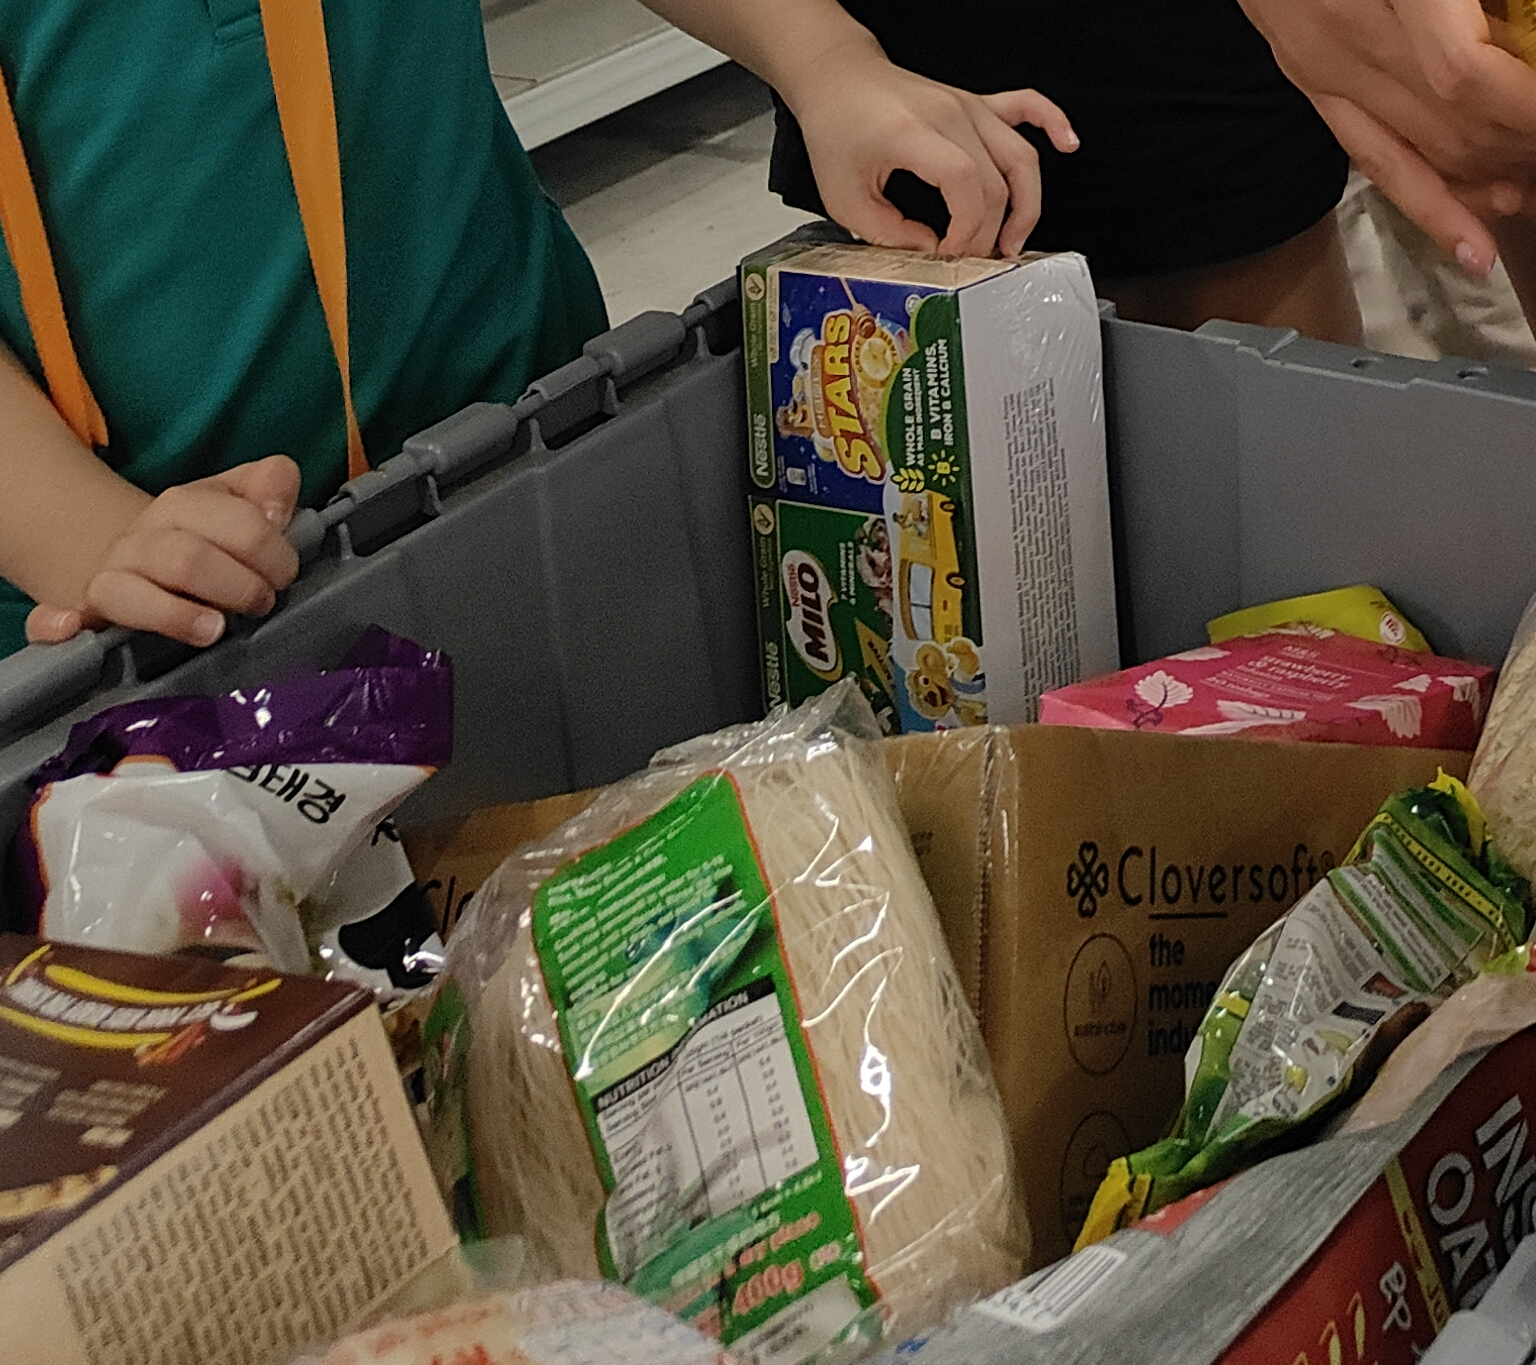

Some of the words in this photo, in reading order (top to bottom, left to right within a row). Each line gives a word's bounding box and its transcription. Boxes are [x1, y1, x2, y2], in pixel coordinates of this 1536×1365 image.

[902, 367, 914, 411] GRAIN
[938, 338, 952, 397] CALCIUM
[824, 314, 882, 479] STARS
[905, 416, 917, 467] WHOLE
[931, 428, 942, 440] B
[943, 413, 954, 446] IRON
[798, 562, 830, 663] MILO
[1149, 933, 1186, 967] the
